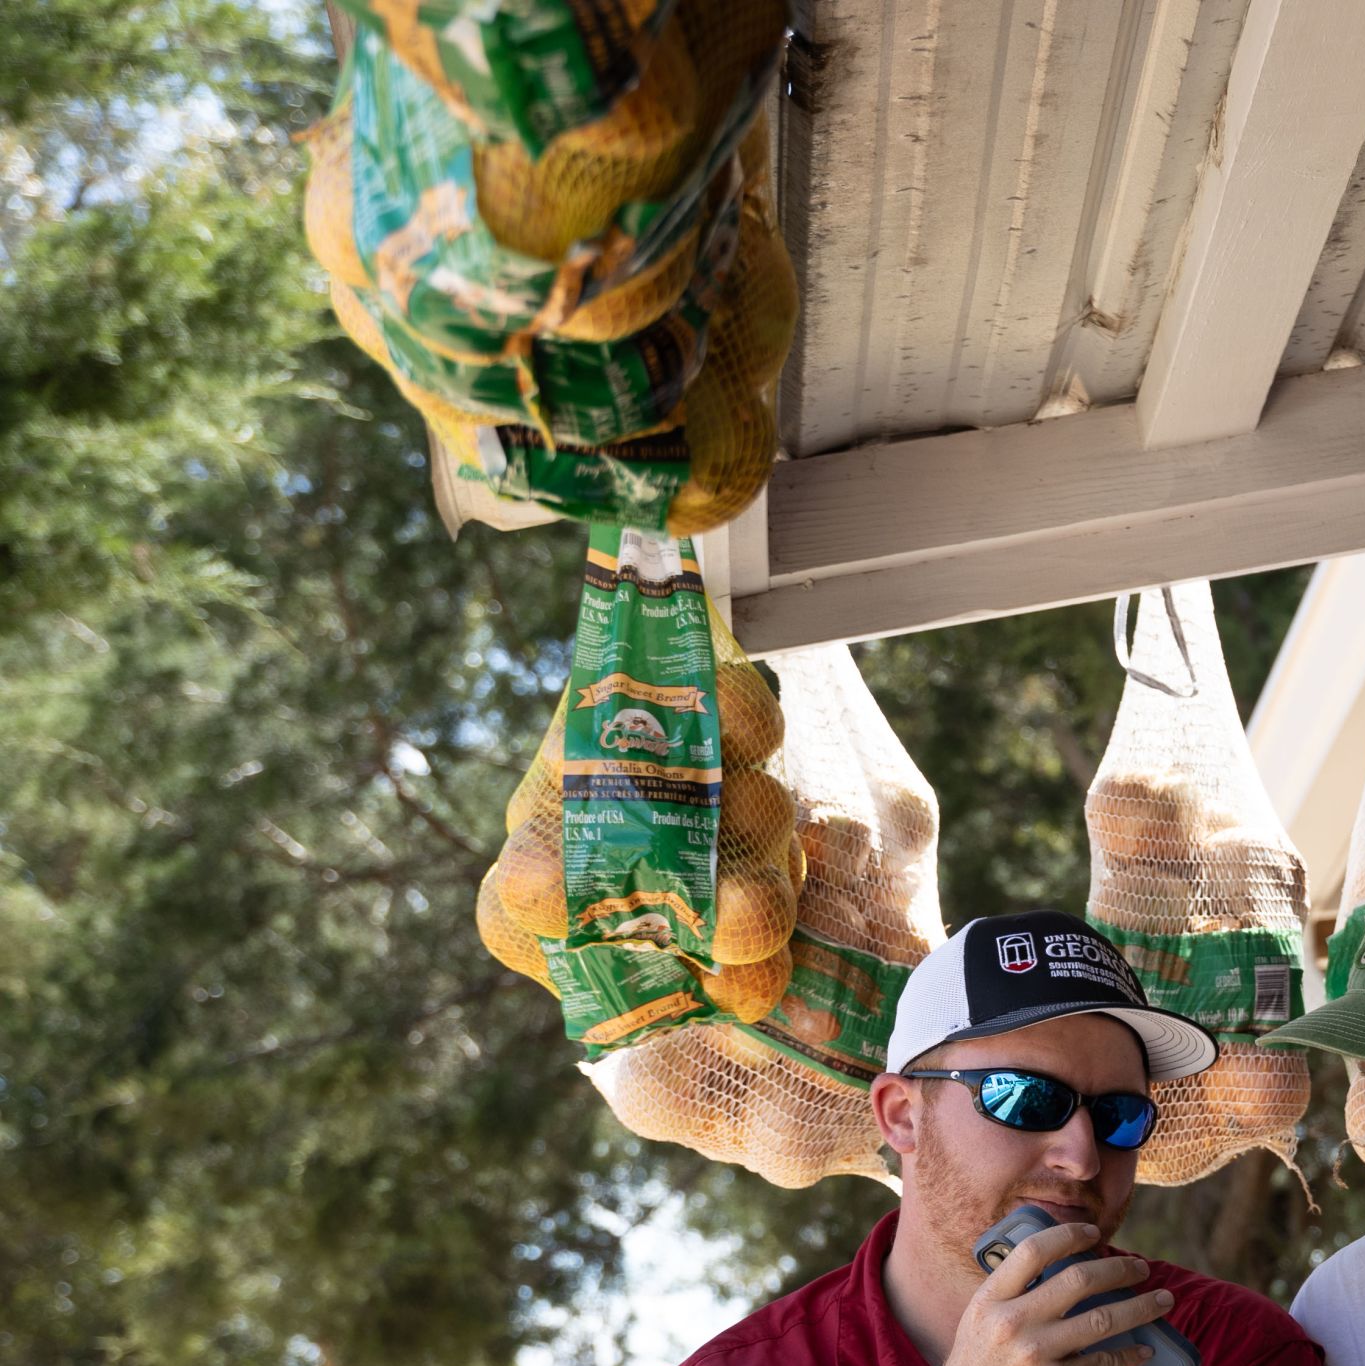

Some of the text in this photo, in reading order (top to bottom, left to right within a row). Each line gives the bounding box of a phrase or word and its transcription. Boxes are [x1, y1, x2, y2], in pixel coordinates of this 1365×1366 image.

[641, 604, 669, 618] Produit
[602, 762, 685, 780] Vidalia Onions
[591, 778, 631, 787] PREMIUM
[634, 779, 663, 788] SWEET
[564, 809, 625, 824] Produce of USA
[652, 810, 681, 826] Produit
[682, 813, 694, 828] des
[565, 827, 581, 841] U.S.
[596, 827, 601, 841] 1
[687, 831, 703, 845] U.S.
[1045, 941, 1138, 992] GEORGIA
[1049, 961, 1100, 976] SOUTHWEST
[1050, 970, 1070, 978] AND
